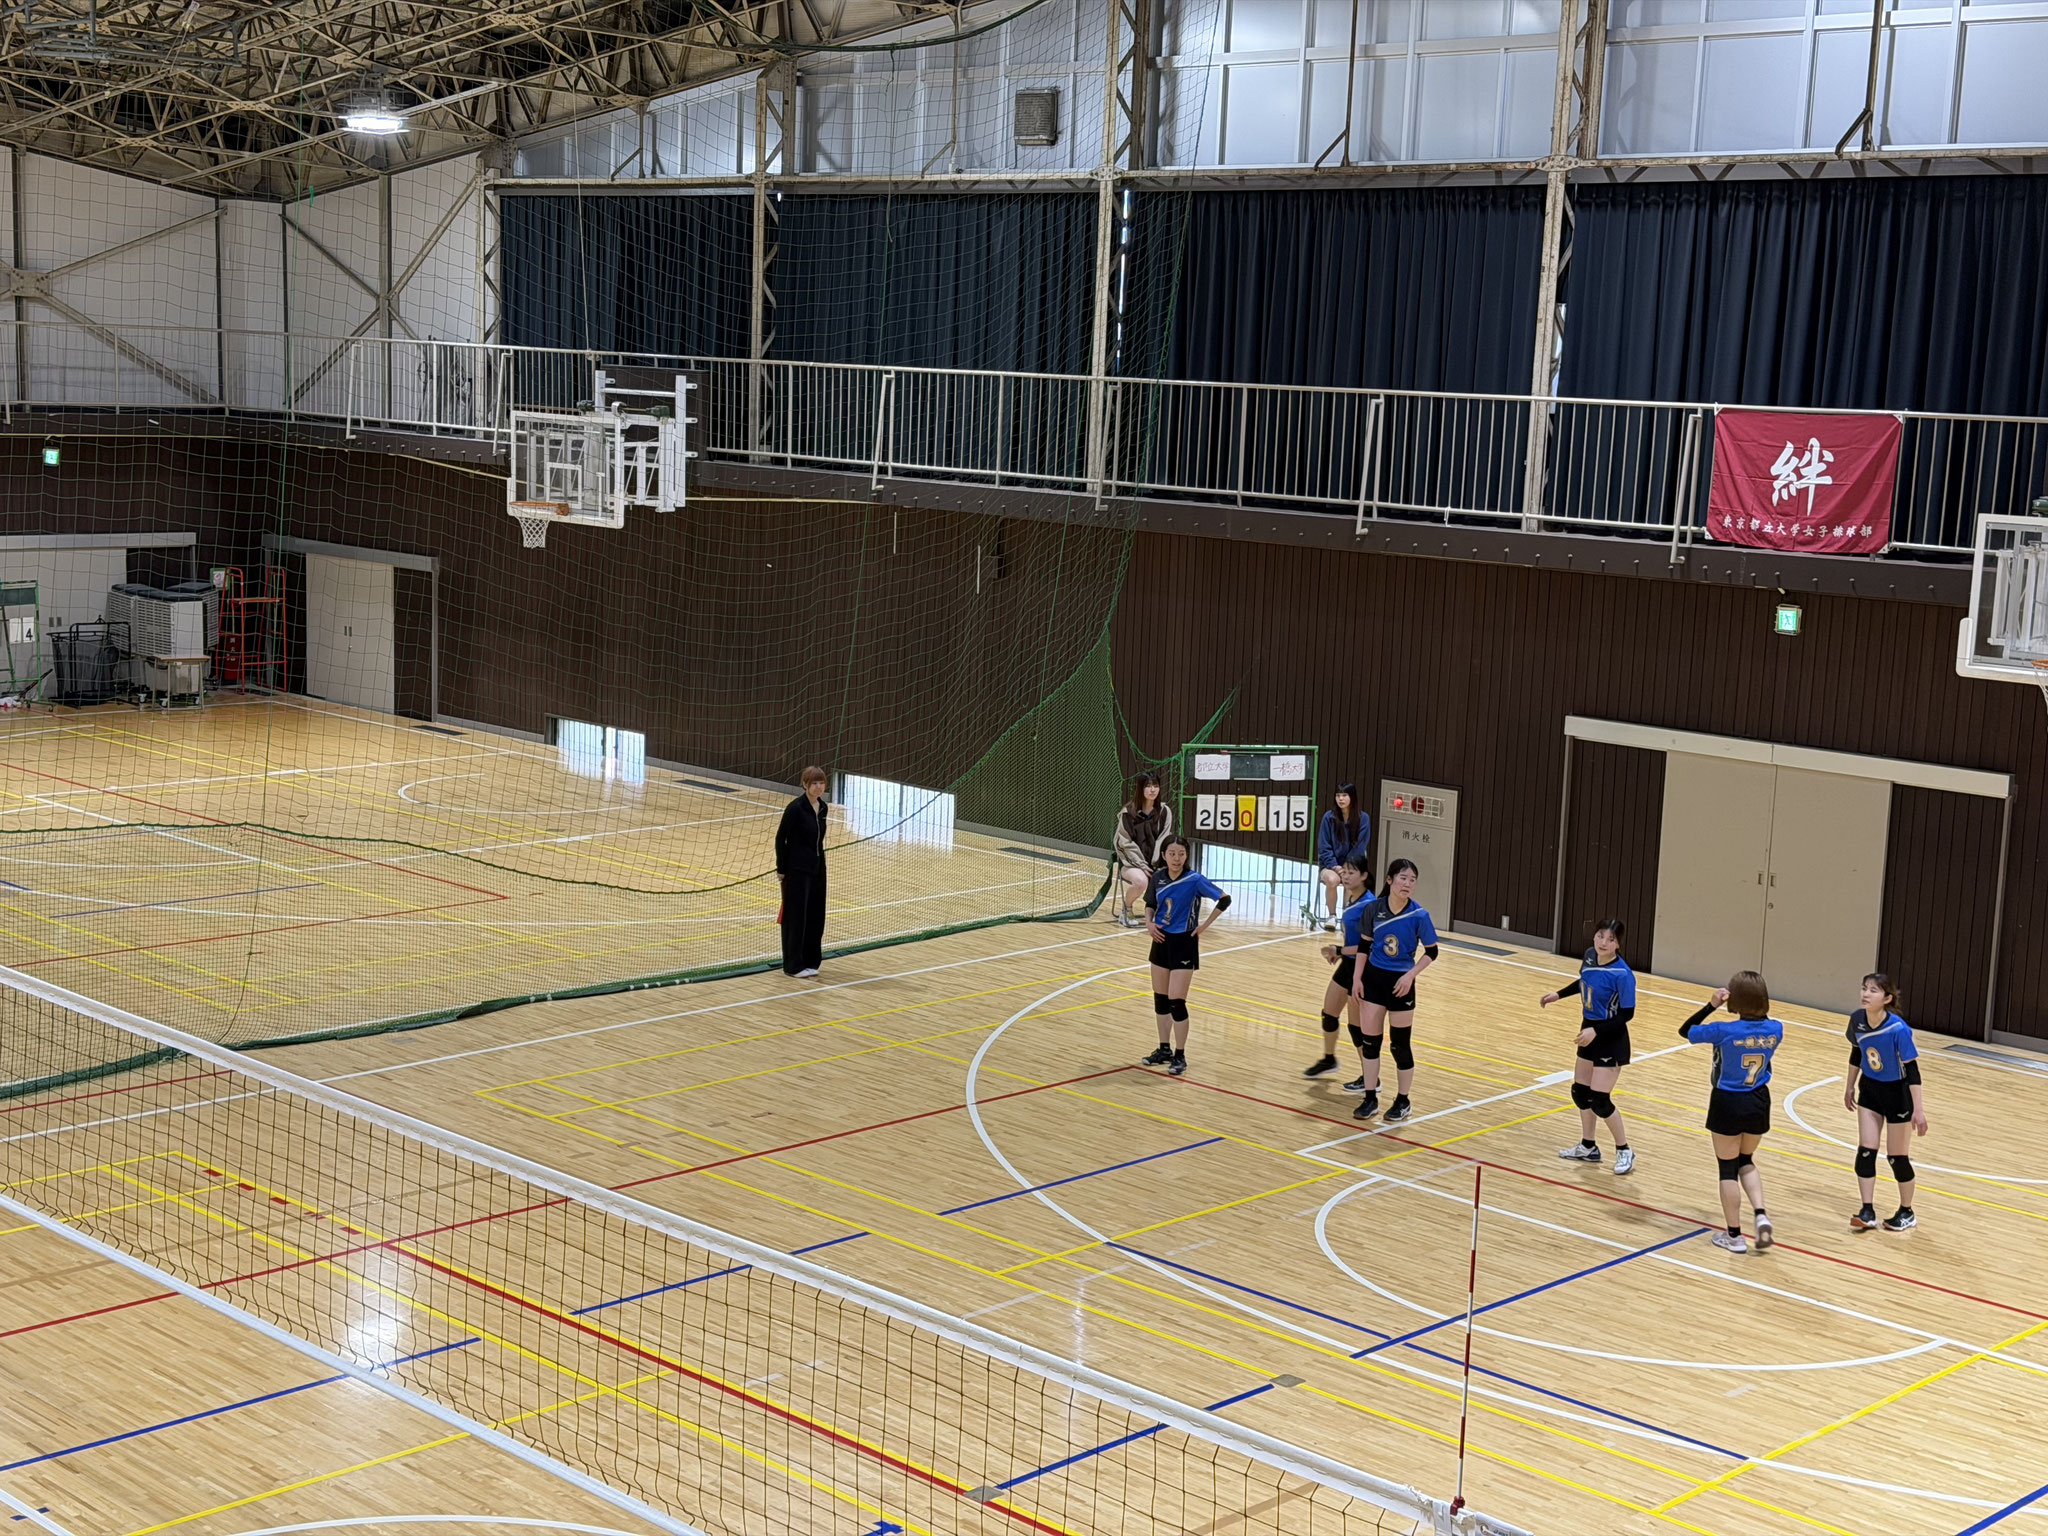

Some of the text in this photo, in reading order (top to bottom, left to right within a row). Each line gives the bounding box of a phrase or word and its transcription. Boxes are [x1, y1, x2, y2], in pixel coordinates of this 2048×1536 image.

[1770, 437, 1834, 516] 絆
[1722, 514, 1873, 538] 東京都立大学女子排球部
[25, 627, 33, 641] 4
[1402, 829, 1431, 844] 消火栓
[1383, 934, 1400, 957] 3
[1741, 1053, 1765, 1086] 7
[1866, 1046, 1884, 1072] 8
